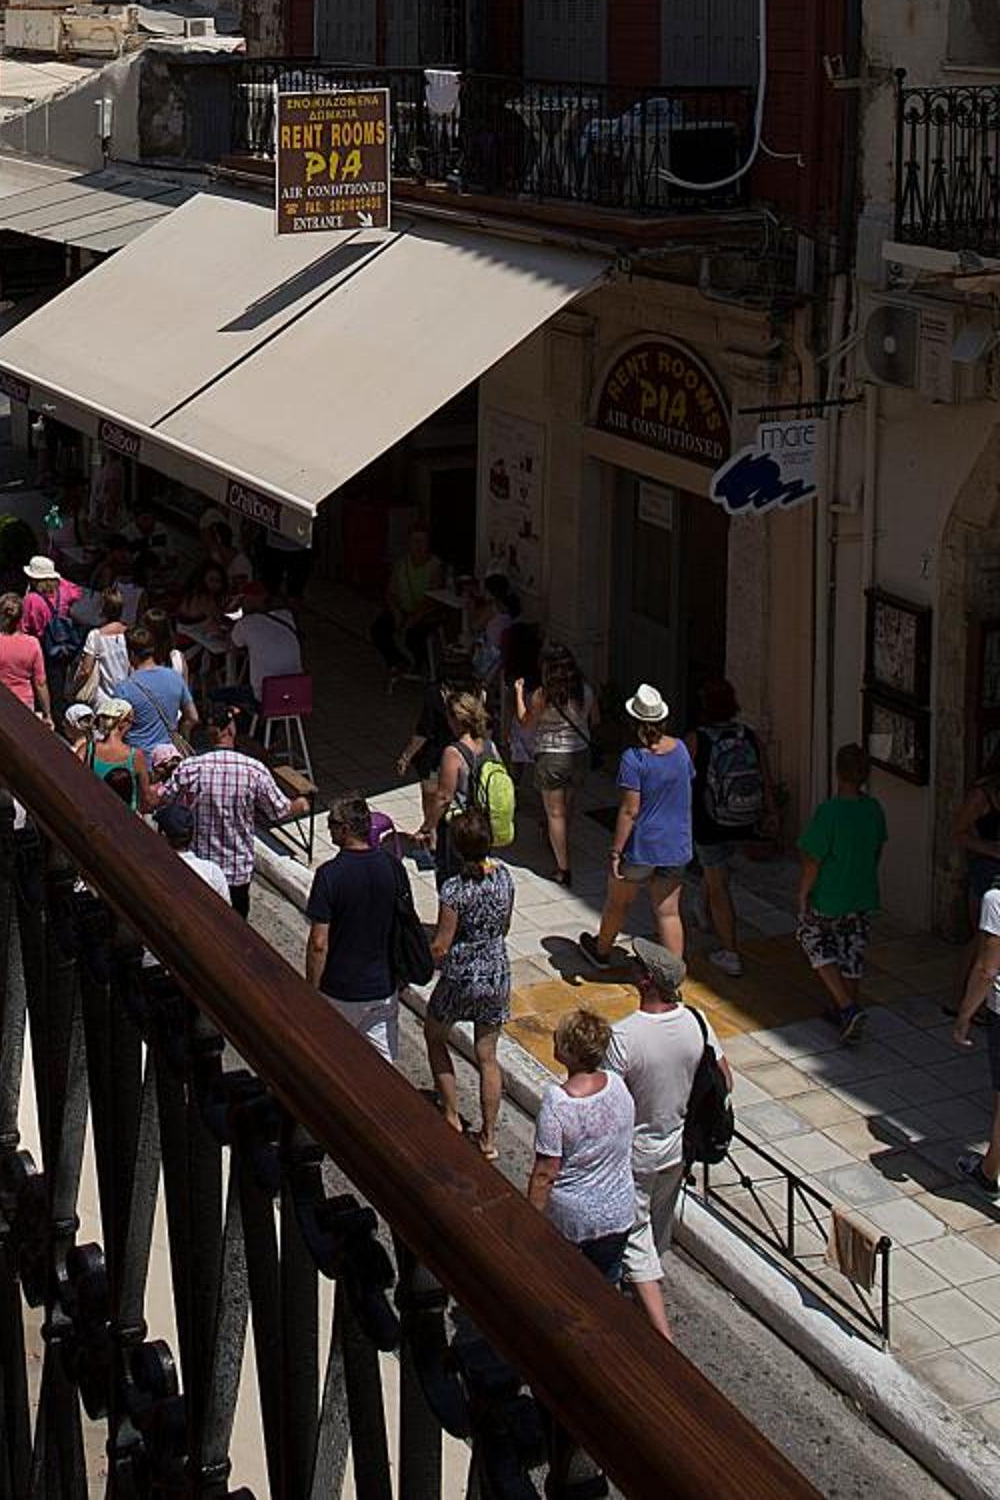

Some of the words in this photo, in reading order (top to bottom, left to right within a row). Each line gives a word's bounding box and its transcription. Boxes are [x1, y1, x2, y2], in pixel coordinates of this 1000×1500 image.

[281, 123, 323, 149] RENT
[331, 120, 385, 148] ROOMS
[304, 149, 362, 182] PIA
[281, 187, 303, 199] AIR
[307, 181, 386, 197] CONDITIONED
[293, 215, 344, 231] ENTRANCE
[607, 352, 649, 402] RENT
[657, 353, 722, 432] ROOMS
[639, 377, 688, 425] PIA
[604, 405, 629, 429] AIR
[631, 417, 724, 460] CONDITIONED
